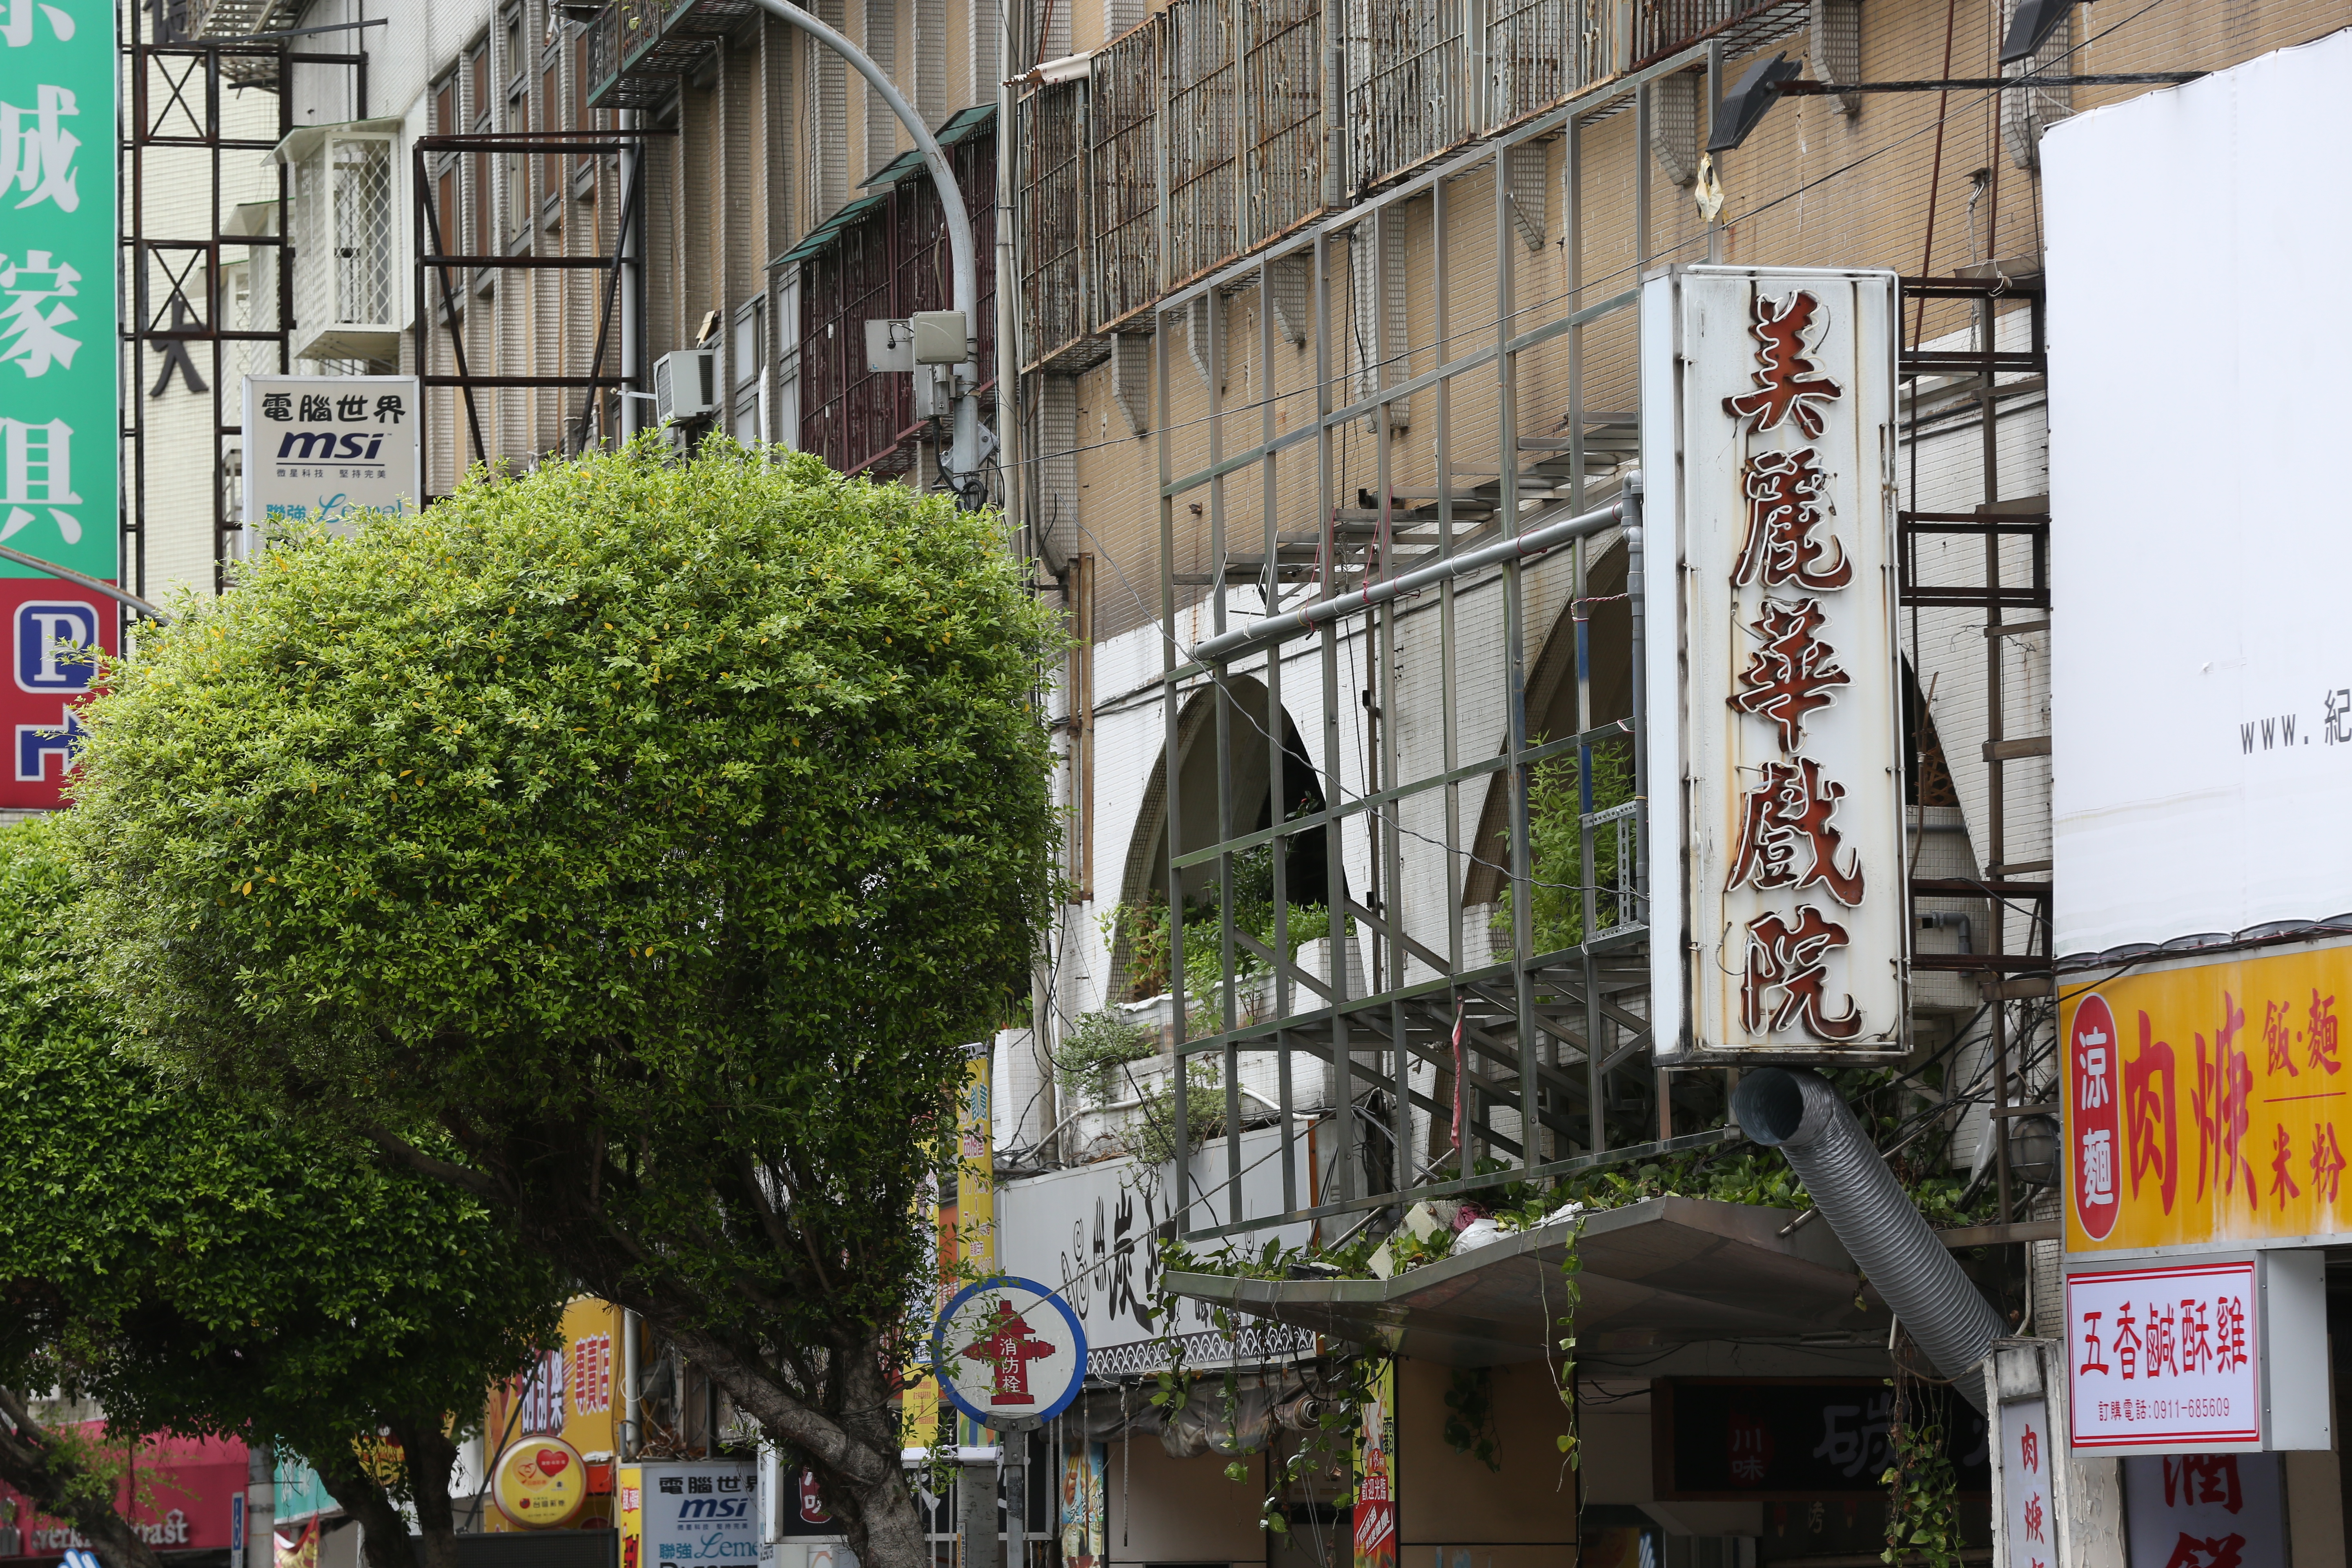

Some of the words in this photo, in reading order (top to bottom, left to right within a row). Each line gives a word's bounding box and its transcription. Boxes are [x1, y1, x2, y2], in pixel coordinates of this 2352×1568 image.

[262, 393, 406, 424] 電腦世界
[277, 432, 384, 459] msi
[276, 469, 323, 478] 微星科技
[339, 470, 386, 479] 堅持完美
[1722, 289, 1867, 1041] 美麗華戲院
[2078, 1026, 2114, 1209] 涼麵
[2124, 990, 2258, 1217] 肉焿
[2269, 1121, 2347, 1212] 米粉
[999, 1337, 1021, 1393] 消防栓
[2080, 1295, 2248, 1381] 五香鹹酥雞
[575, 1330, 610, 1416] 專賣店
[1723, 1428, 1765, 1481] 川味
[679, 1498, 748, 1518] msi
[1361, 1477, 1387, 1501] 歡迎光臨
[2020, 1423, 2045, 1568] 肉焿
[659, 1543, 693, 1559] 聯強
